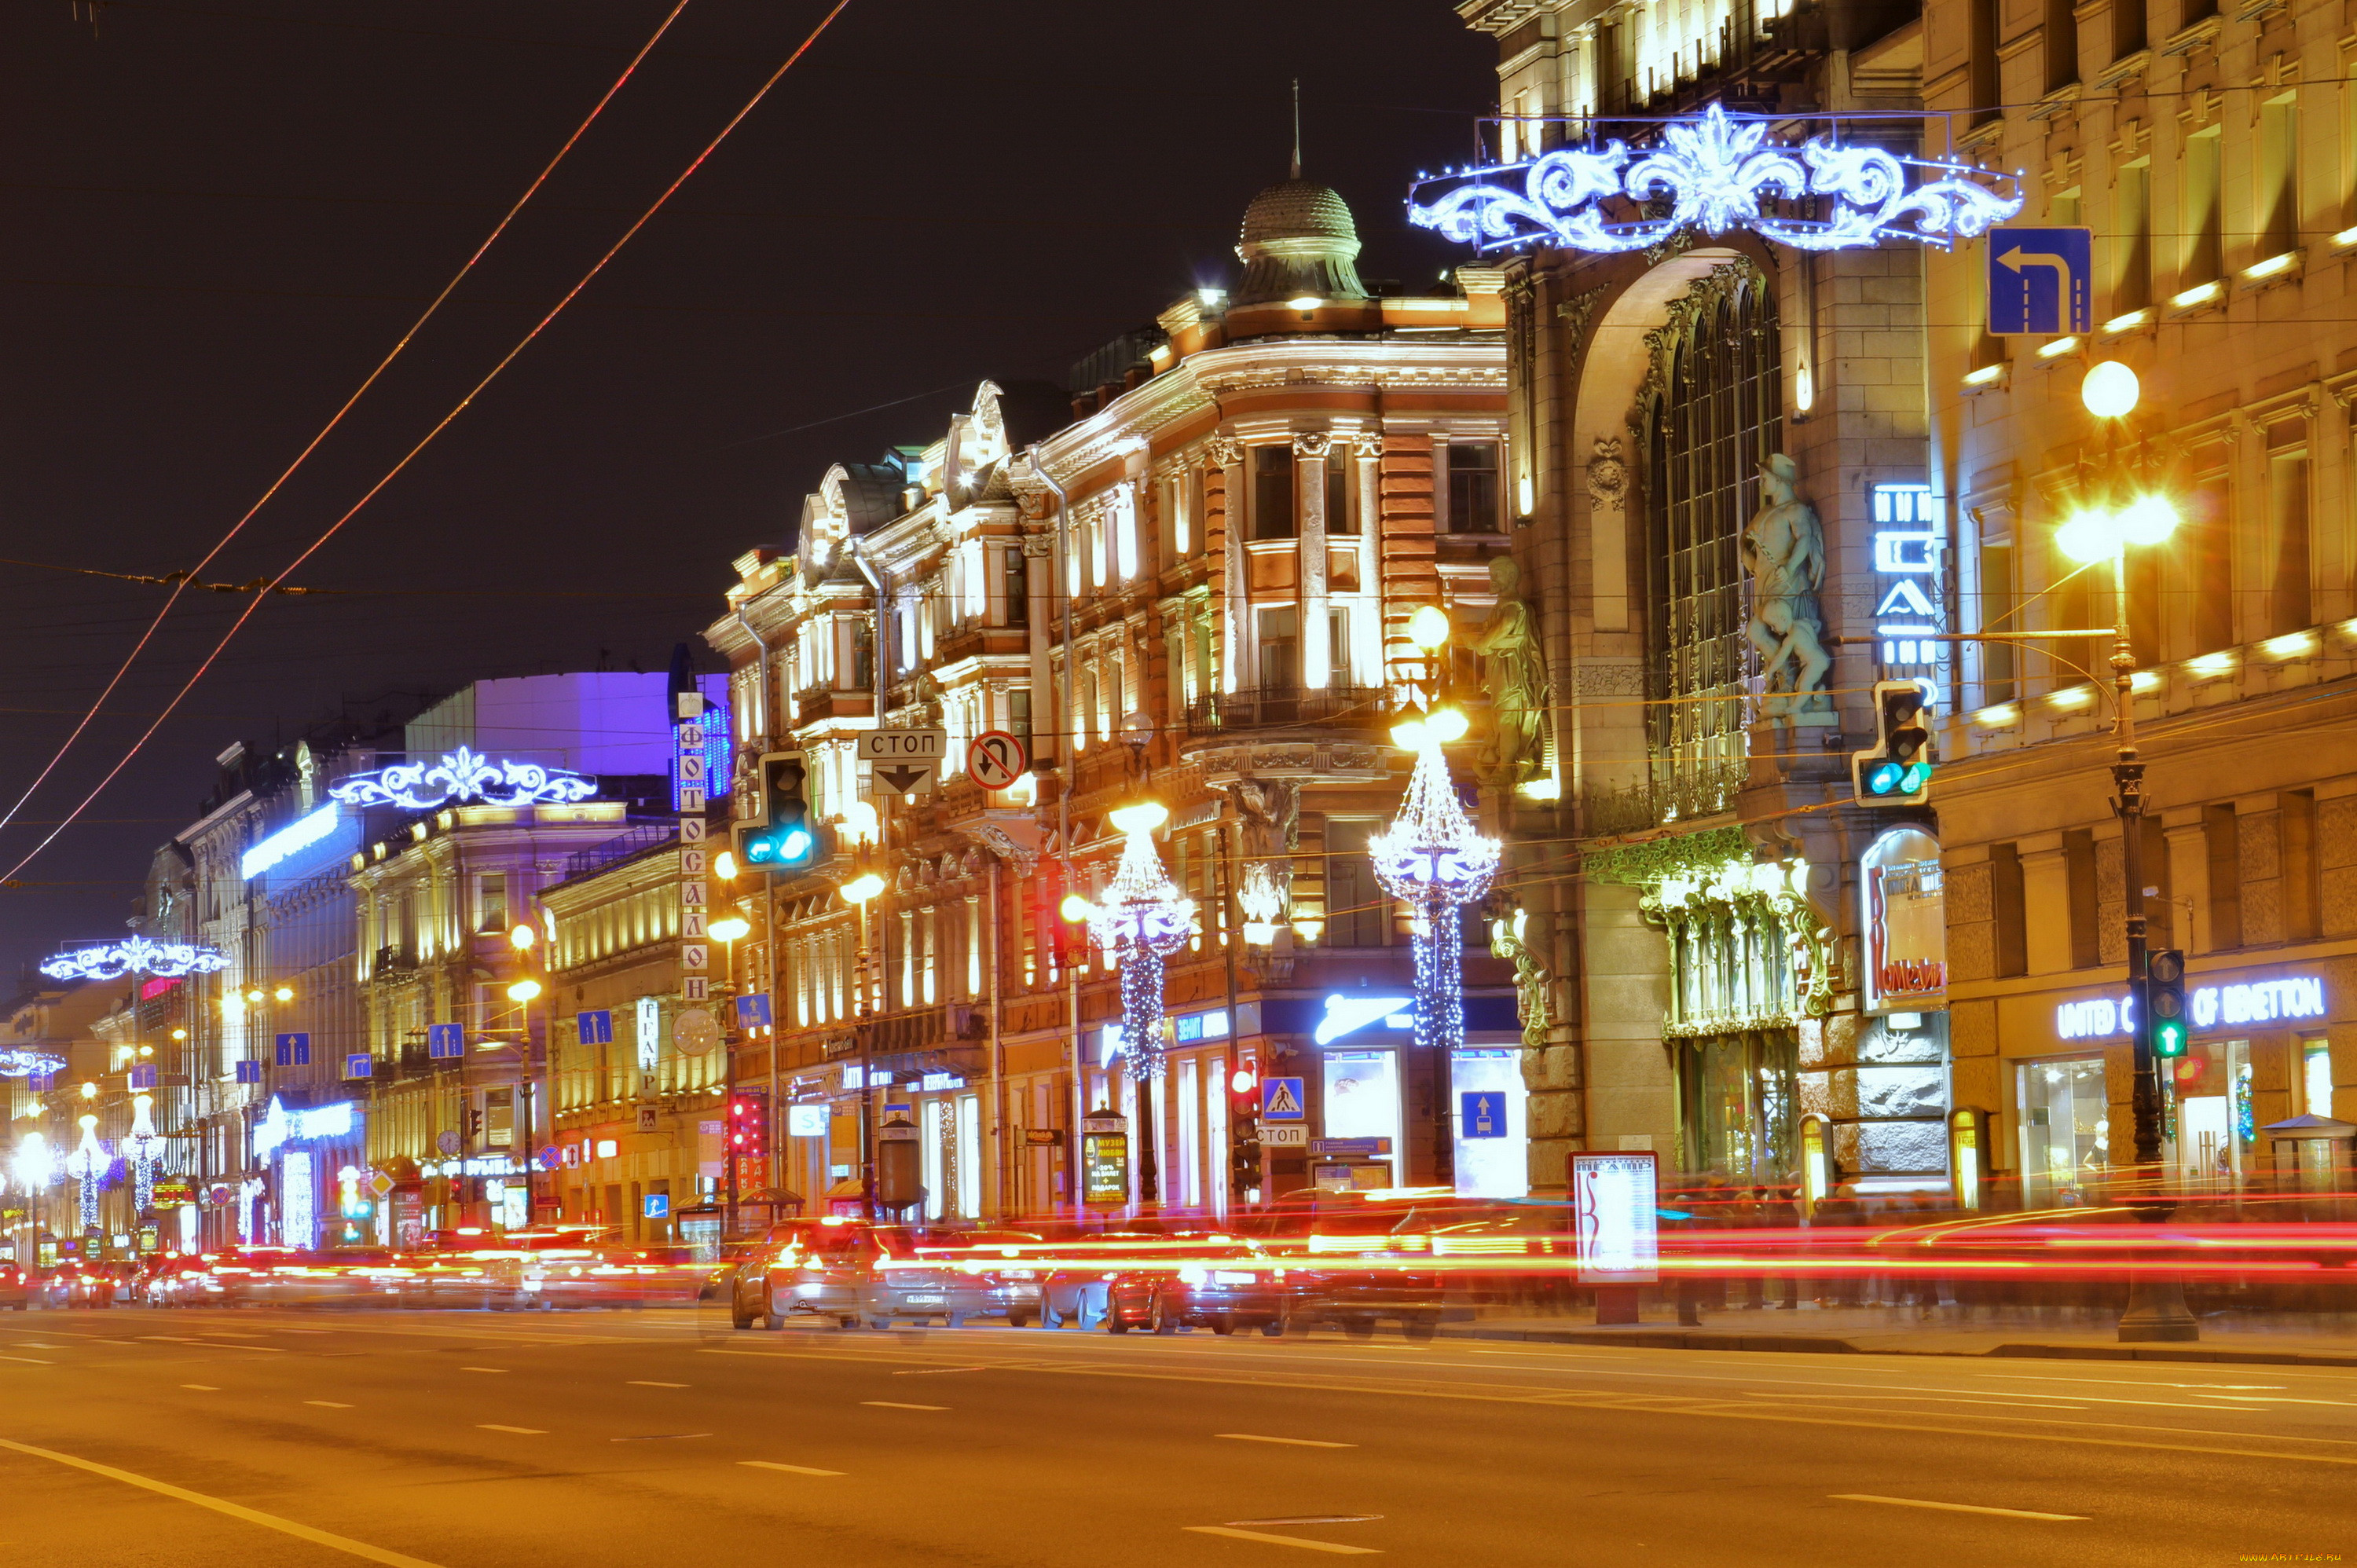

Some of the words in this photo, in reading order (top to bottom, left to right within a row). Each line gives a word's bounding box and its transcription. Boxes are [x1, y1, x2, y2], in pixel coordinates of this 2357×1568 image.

[871, 735, 937, 753] СТОП
[680, 724, 708, 1000] ФОТОСАЛОН
[2057, 999, 2116, 1039] UNITED
[2192, 987, 2219, 1027] OF
[1178, 1017, 1201, 1042] ЗЕНИТ
[641, 1002, 657, 1090] ТЕАТР
[1098, 1138, 1125, 1147] МУЗЕЙ
[1255, 1129, 1299, 1142] СТОП
[1098, 1149, 1125, 1157] ЛЮБВИ
[1576, 1163, 1652, 1171] ТЕАТР
